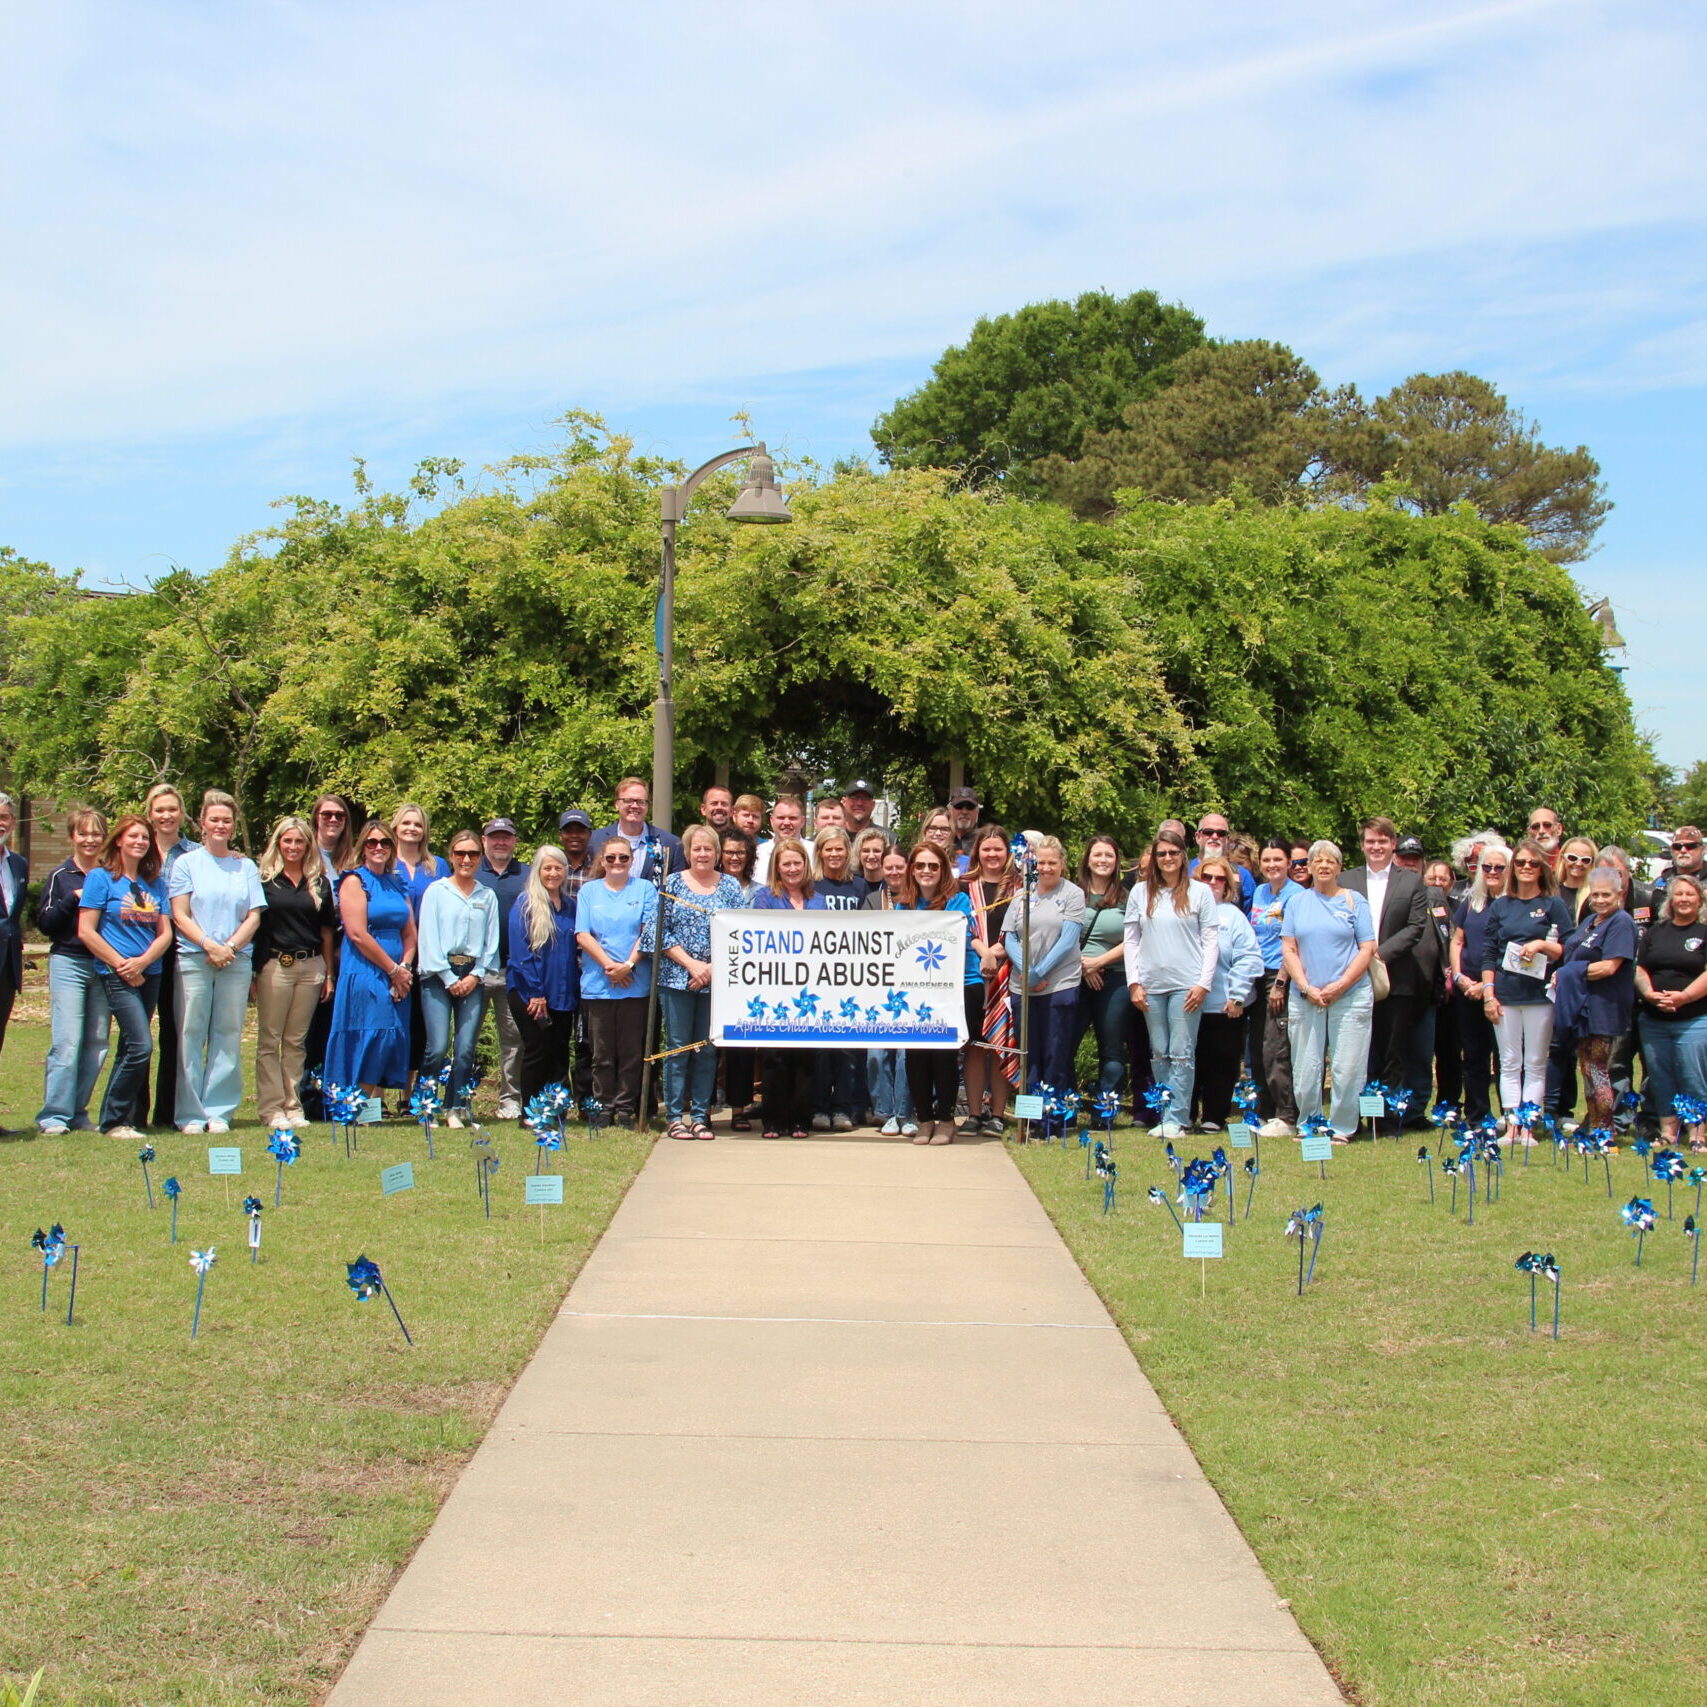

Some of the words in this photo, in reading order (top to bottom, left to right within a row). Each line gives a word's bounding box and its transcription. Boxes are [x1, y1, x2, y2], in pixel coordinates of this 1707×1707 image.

[728, 929, 739, 941] A
[741, 930, 804, 954] STAND
[809, 931, 894, 955] AGAINST
[728, 945, 739, 987] TAKE
[741, 961, 810, 986] CHILD
[816, 962, 895, 987] ABUSE
[900, 981, 954, 989] AWARENESS
[734, 1016, 763, 1039] April
[779, 1016, 809, 1033] Child
[812, 1017, 846, 1033] Abuse
[849, 1018, 909, 1034] Awareness
[911, 1017, 948, 1034] Month
